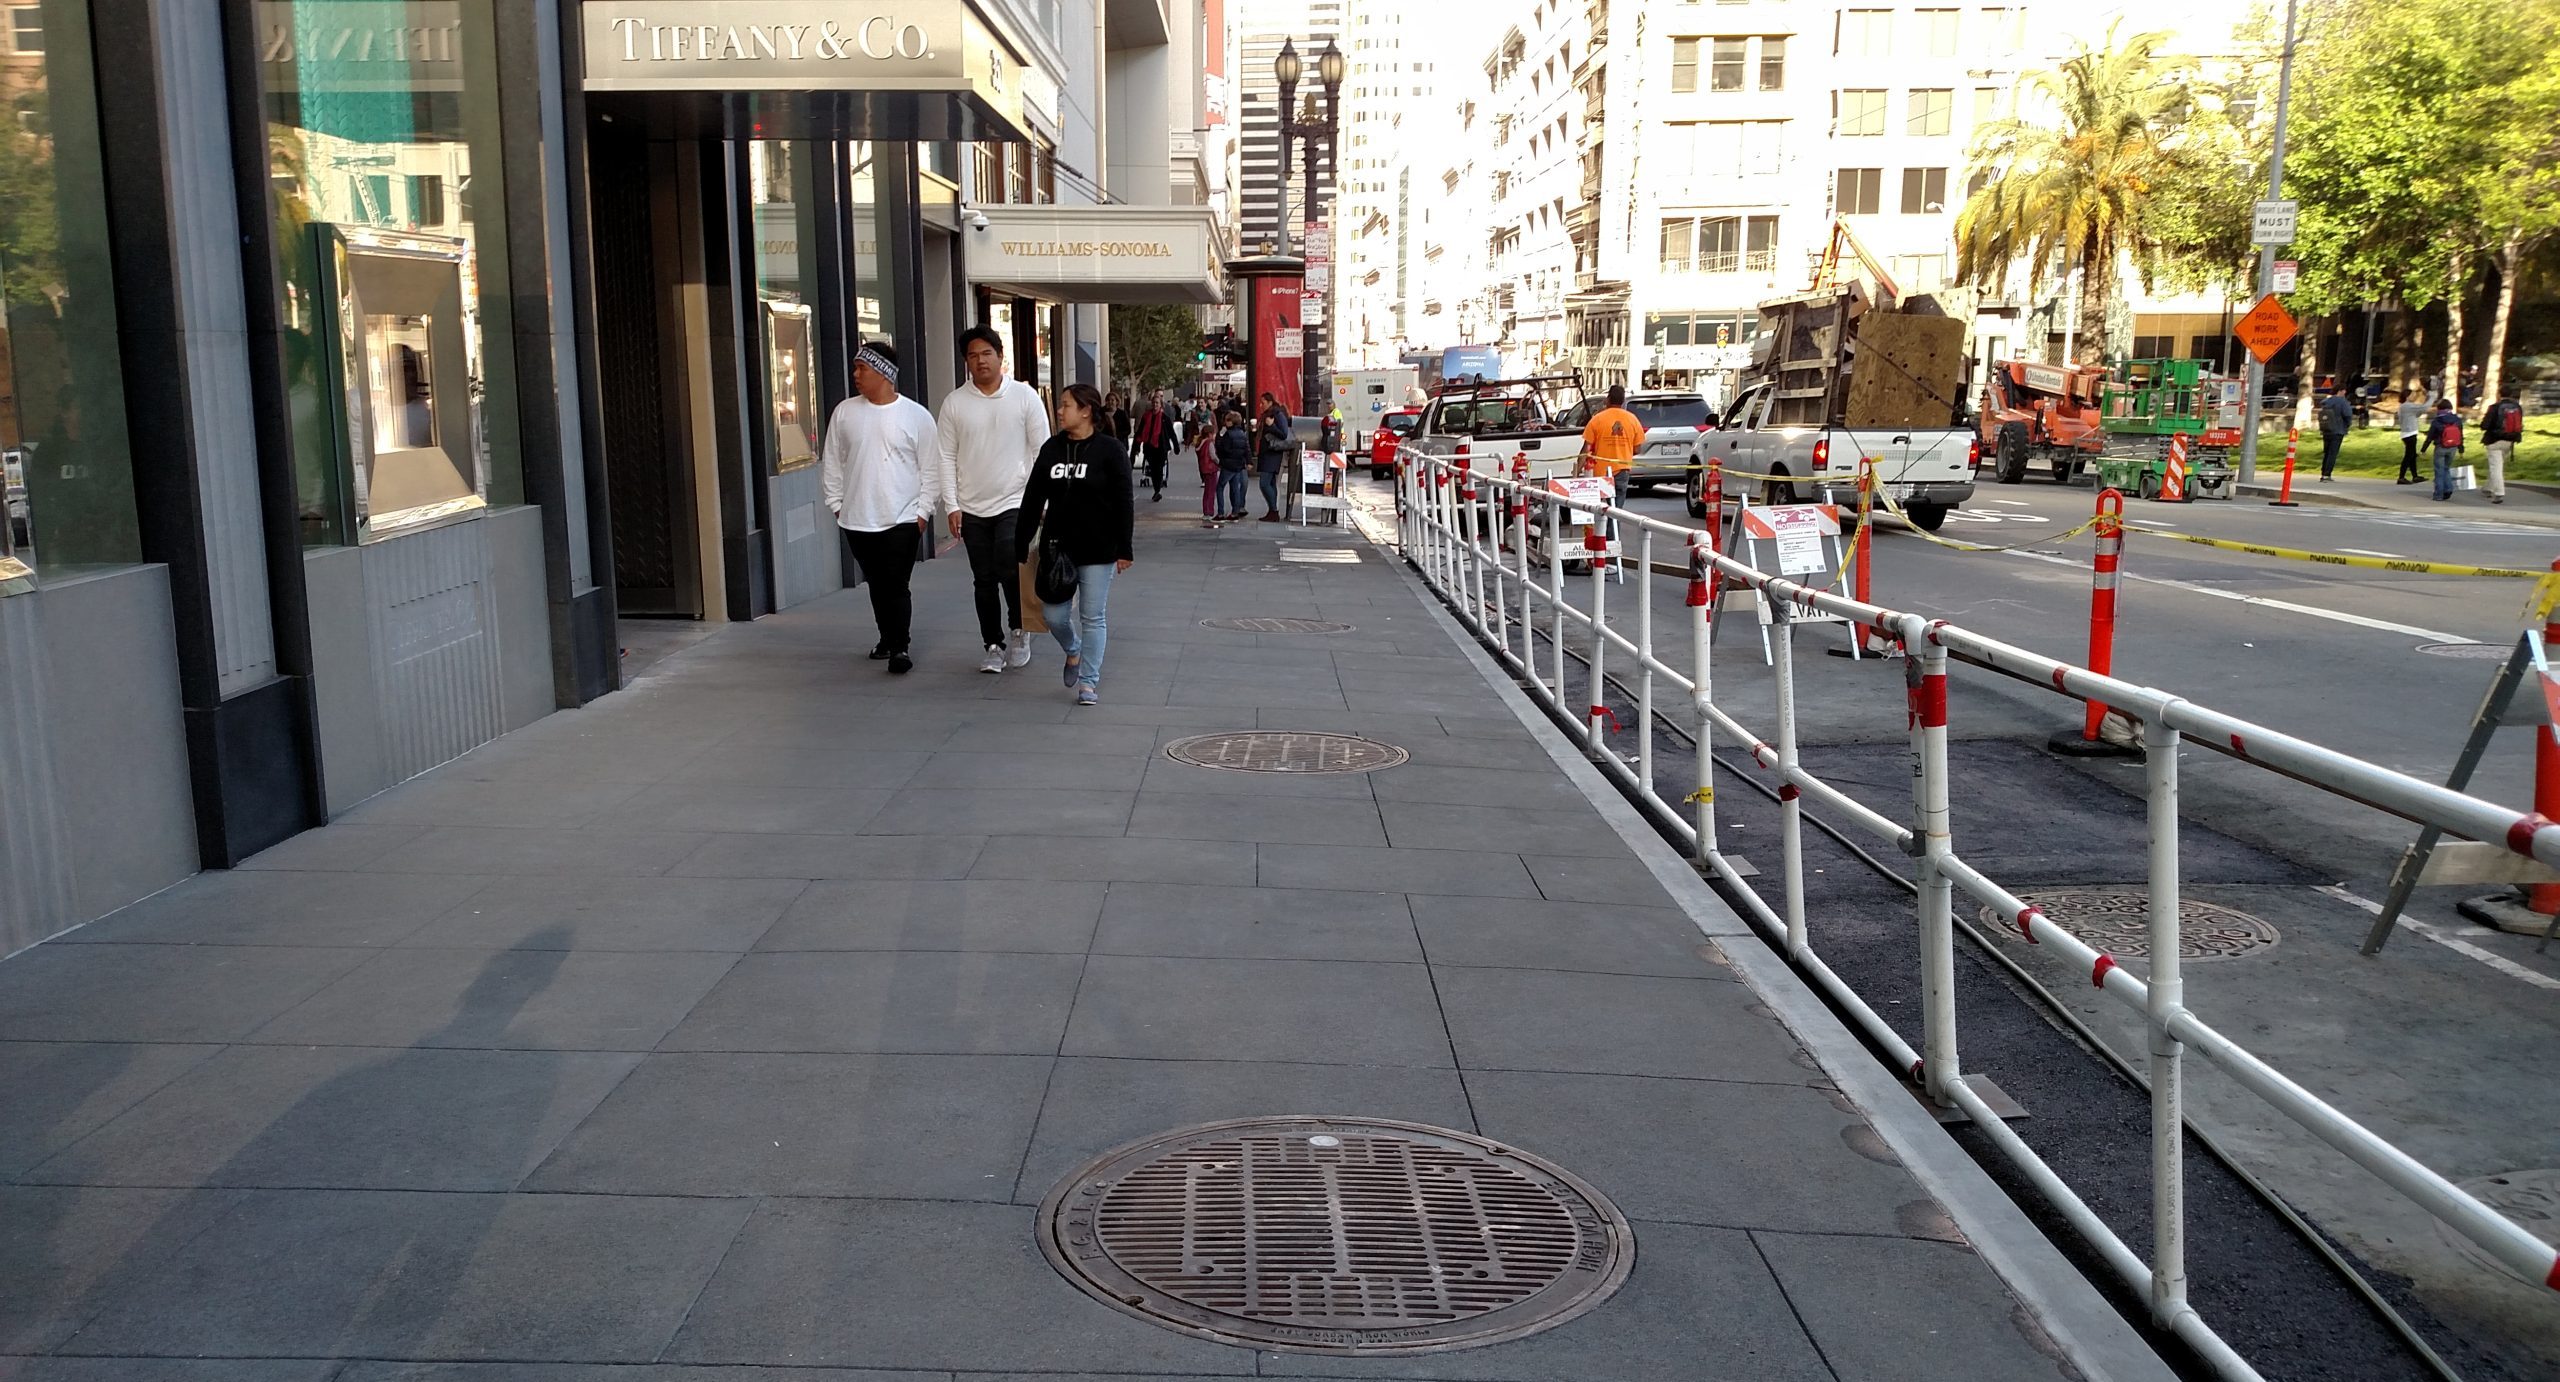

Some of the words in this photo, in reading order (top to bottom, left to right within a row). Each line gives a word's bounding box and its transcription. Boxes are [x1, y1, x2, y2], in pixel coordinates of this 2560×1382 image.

[611, 17, 811, 61] TIFFANY
[815, 20, 852, 60] &
[2259, 217, 2290, 227] MUST
[1001, 241, 1172, 257] WILLIAMS-SONOMA
[2255, 312, 2279, 320] ROAD
[2254, 325, 2278, 333] WORK
[2250, 337, 2280, 346] AHEAD
[1540, 1181, 1602, 1237] VOLTAGE
[1575, 1240, 1605, 1273] HIGH
